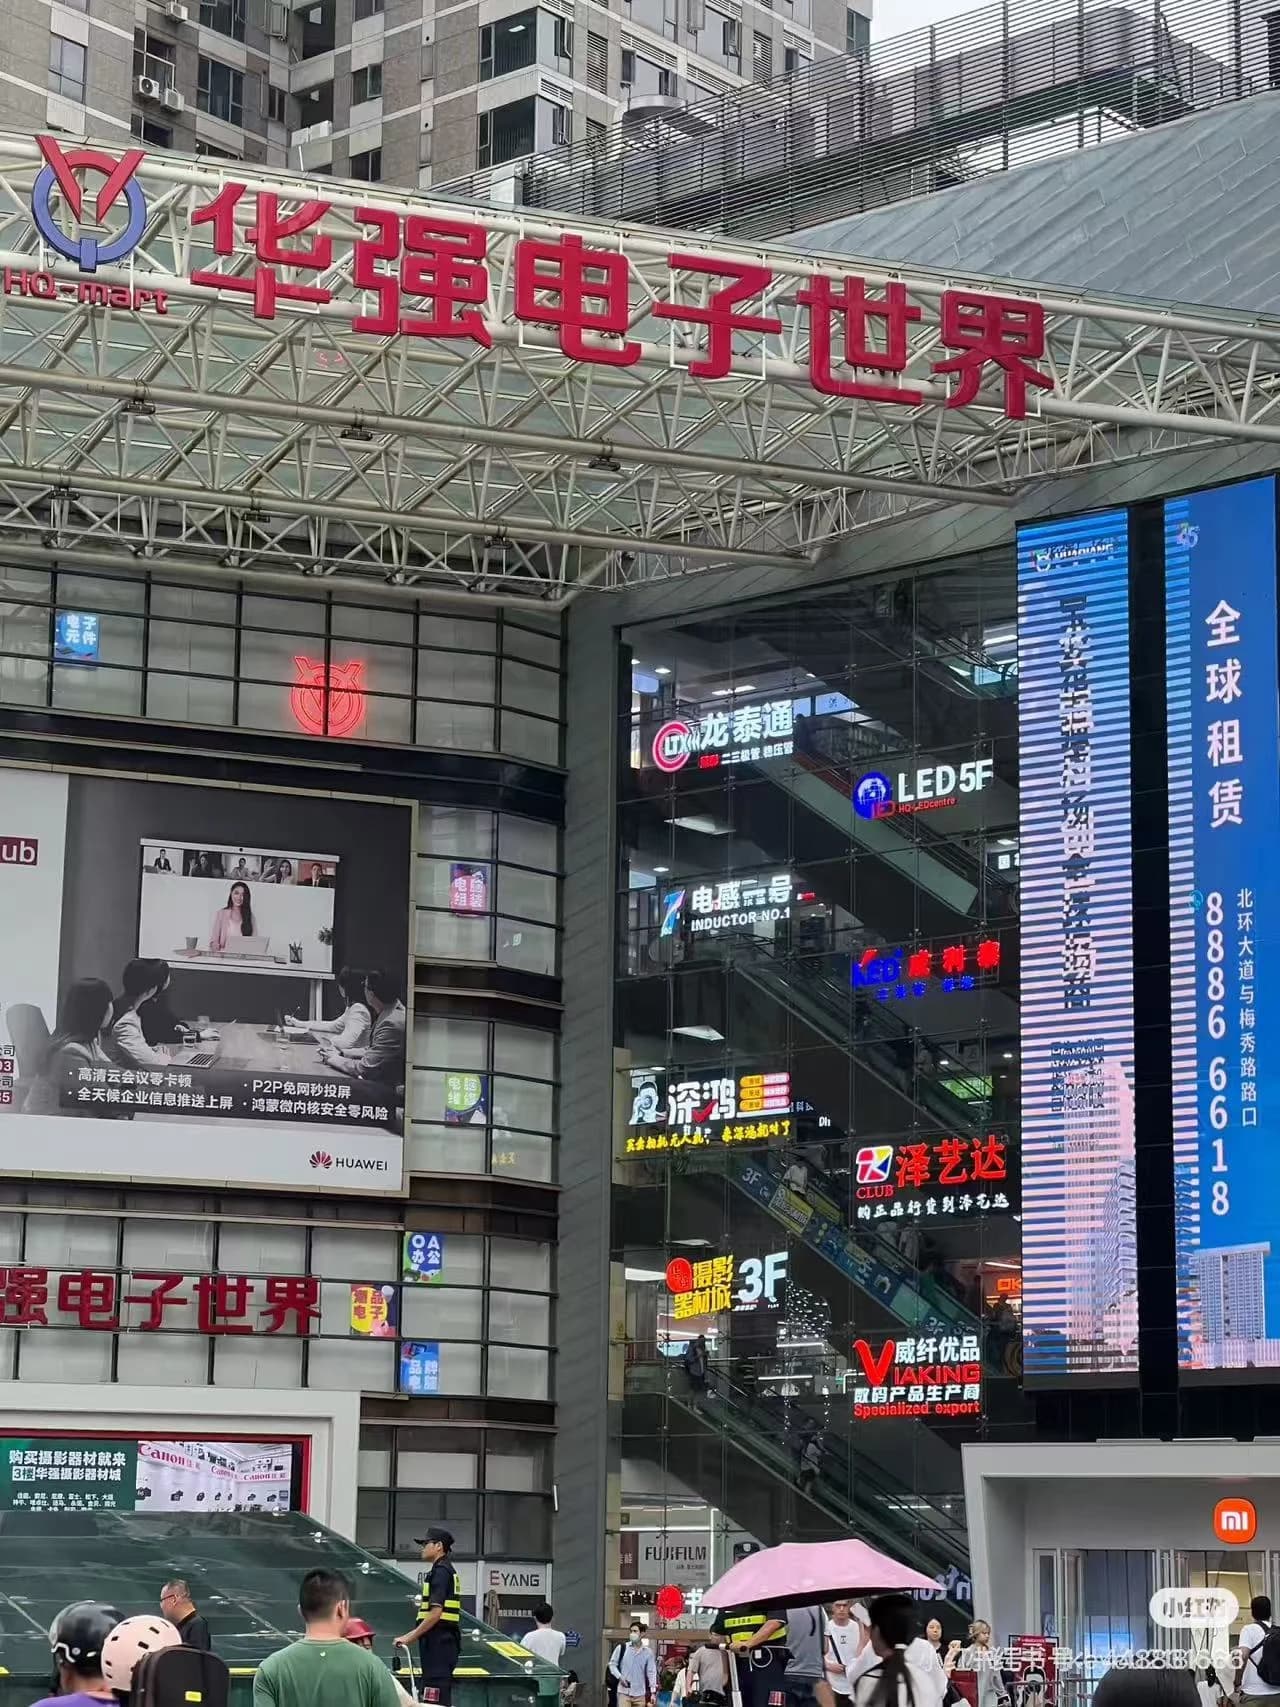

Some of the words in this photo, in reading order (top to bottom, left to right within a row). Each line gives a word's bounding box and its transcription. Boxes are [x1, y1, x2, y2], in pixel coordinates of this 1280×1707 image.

[3, 267, 168, 314] HQ-mart
[190, 182, 1055, 421] 华强电子世界
[701, 700, 793, 750] 龙泰通
[1205, 599, 1243, 828] 全球租赁
[898, 765, 957, 803] LED
[959, 758, 994, 793] 5F
[2, 840, 36, 863] ub
[691, 911, 757, 932] INDUCTOR
[761, 907, 791, 922] NO.1
[1237, 887, 1257, 1127] 北环大道与梅秀路路口
[0, 1044, 15, 1056] 司
[78, 1066, 192, 1088] 高清云会议零卡顿
[252, 1079, 352, 1099] P2P免网秒投屏
[77, 1086, 233, 1110] 全天候企业信息推送上屏
[252, 1097, 389, 1121] 鸿蒙微内核安全零风险
[668, 1078, 736, 1126] 深鸿
[335, 1157, 388, 1171] HUAWEI
[895, 1134, 1007, 1188] 泽艺达
[856, 1184, 895, 1200] CLUB
[412, 1234, 440, 1250] OA
[691, 1254, 734, 1290] 摄影
[738, 1251, 789, 1302] 3F
[0, 1267, 322, 1336] 强电子世界
[353, 1304, 384, 1320] 电子
[673, 1284, 732, 1321] 器材城
[894, 1335, 981, 1364] 威纤优品
[852, 1339, 982, 1387] VIAKING
[854, 1383, 981, 1404] 数码产品生产商
[854, 1401, 929, 1418] Specialized
[935, 1401, 981, 1416] export
[9, 1450, 127, 1467] 购买摄影器材就来
[138, 1443, 186, 1467] Canon
[244, 1473, 270, 1482] Canon
[645, 1546, 707, 1561] FUJIFILM
[490, 1570, 540, 1587] EYANG
